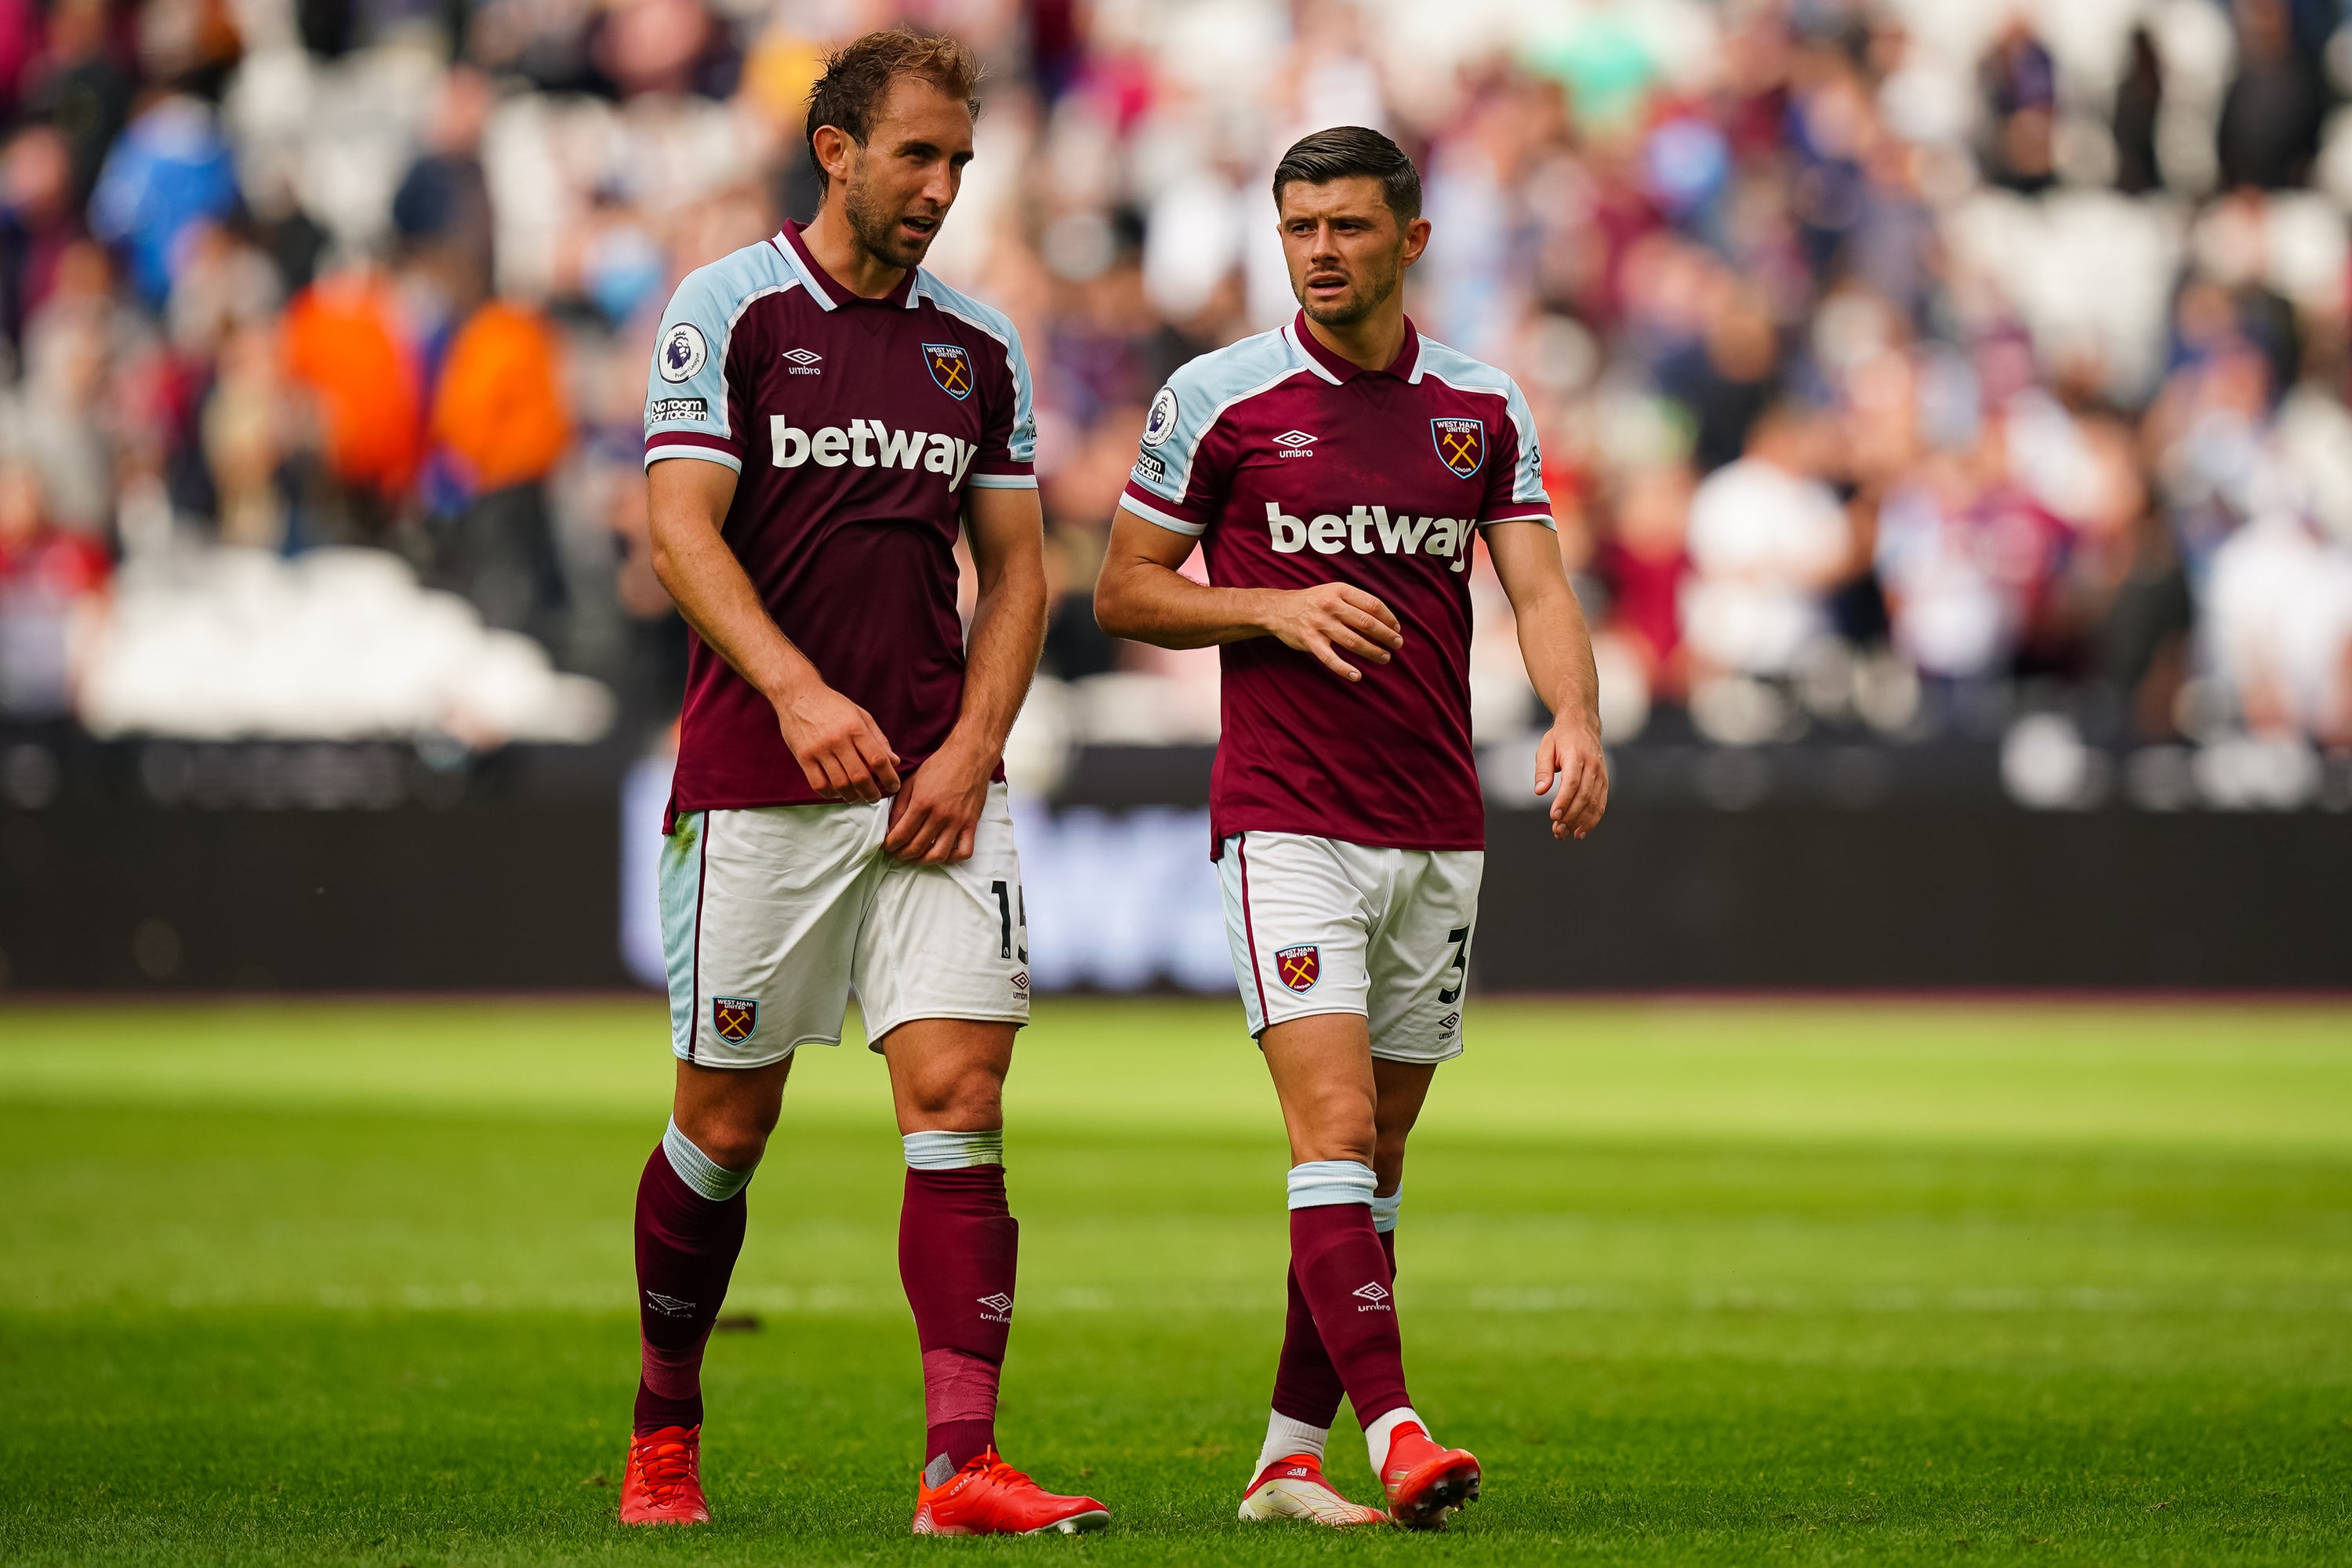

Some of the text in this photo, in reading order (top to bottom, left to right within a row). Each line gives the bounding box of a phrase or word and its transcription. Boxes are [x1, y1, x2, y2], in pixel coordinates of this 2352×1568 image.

[946, 347, 964, 356] HAM
[788, 365, 821, 376] umbro
[651, 400, 702, 413] No room
[666, 409, 707, 421] racism
[769, 414, 978, 493] betway
[1279, 448, 1313, 459] umbro
[1140, 452, 1161, 472] room
[1136, 463, 1163, 484] racism
[1265, 502, 1476, 572] betway
[1279, 948, 1297, 957] WEST
[1437, 921, 1471, 1004] 3
[1012, 991, 1028, 1000] umbr
[1358, 1301, 1391, 1312] umbro
[980, 1312, 1011, 1324] umbro
[949, 1479, 968, 1496] COPA
